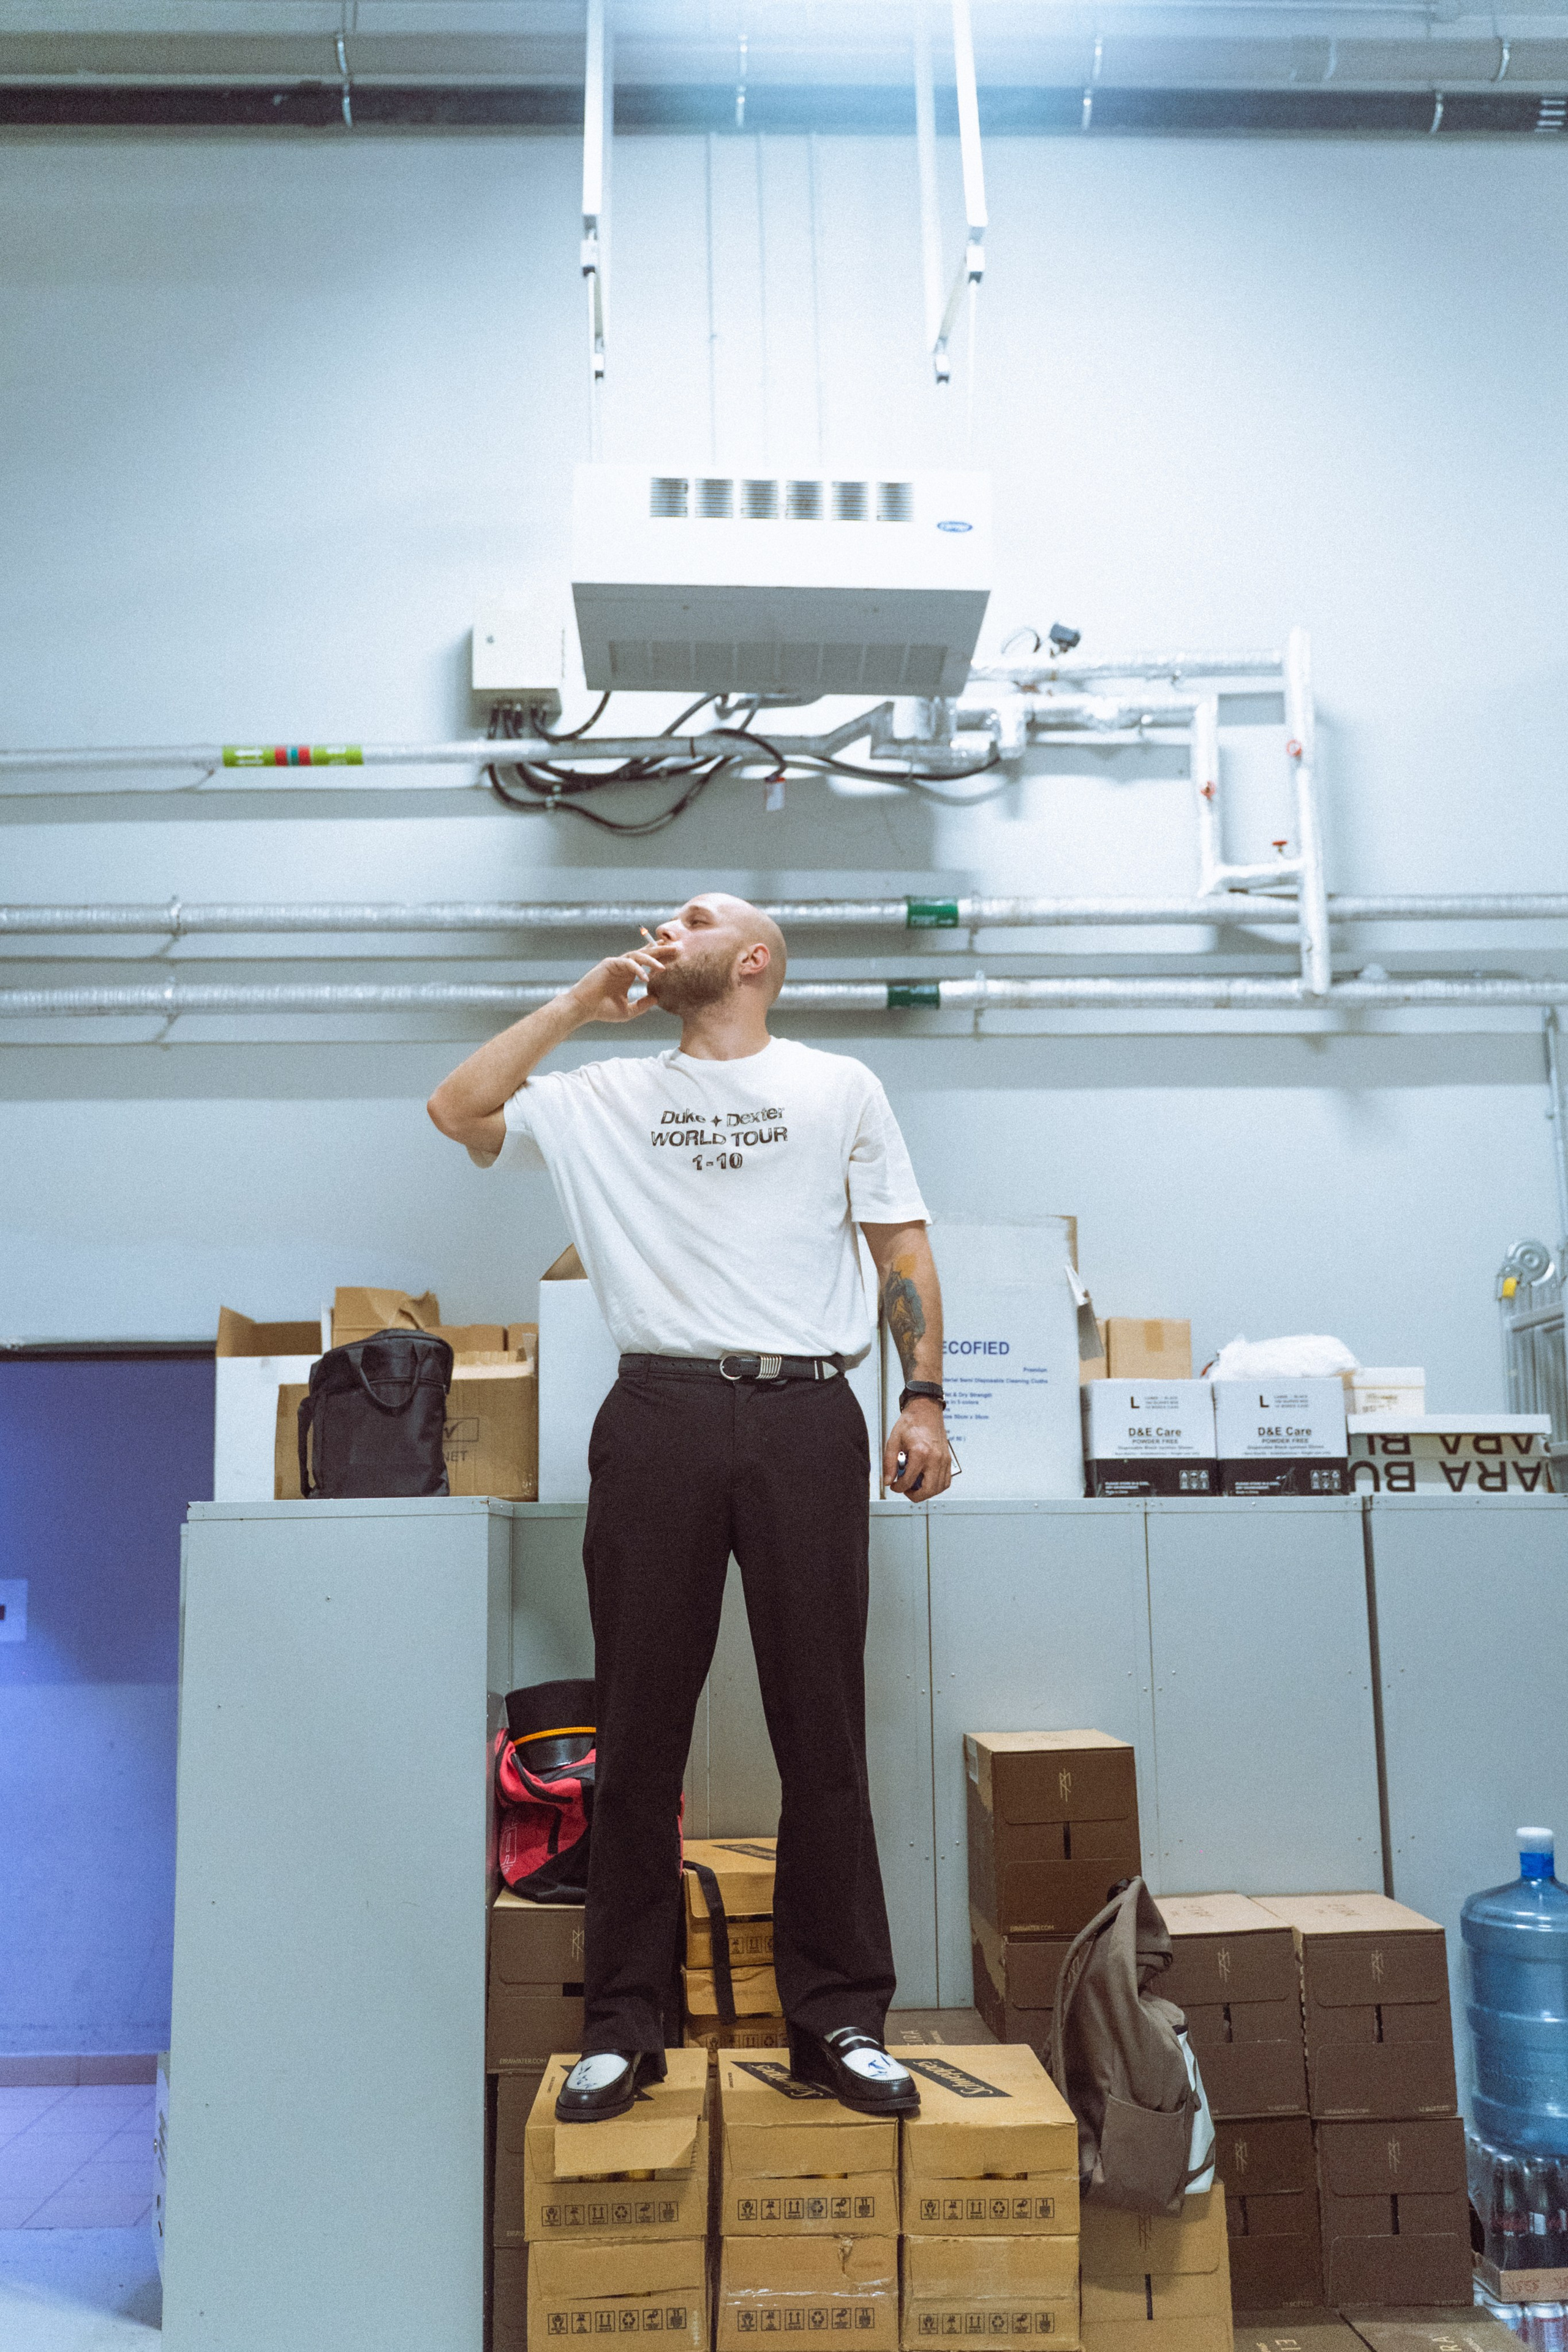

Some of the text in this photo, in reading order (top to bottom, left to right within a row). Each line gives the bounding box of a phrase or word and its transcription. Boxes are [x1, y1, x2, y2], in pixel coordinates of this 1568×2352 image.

[661, 1109, 706, 1125] Duke
[727, 1107, 785, 1127] Dexter
[651, 1126, 788, 1147] WORLD TOUR
[693, 1153, 743, 1170] 1-10
[1131, 1396, 1140, 1409] L
[1259, 1395, 1269, 1408] L
[1129, 1427, 1182, 1436] D&E Care
[1258, 1427, 1312, 1436] D&E Care
[1439, 1461, 1542, 1492] ARA
[912, 2060, 993, 2094] Schweppes
